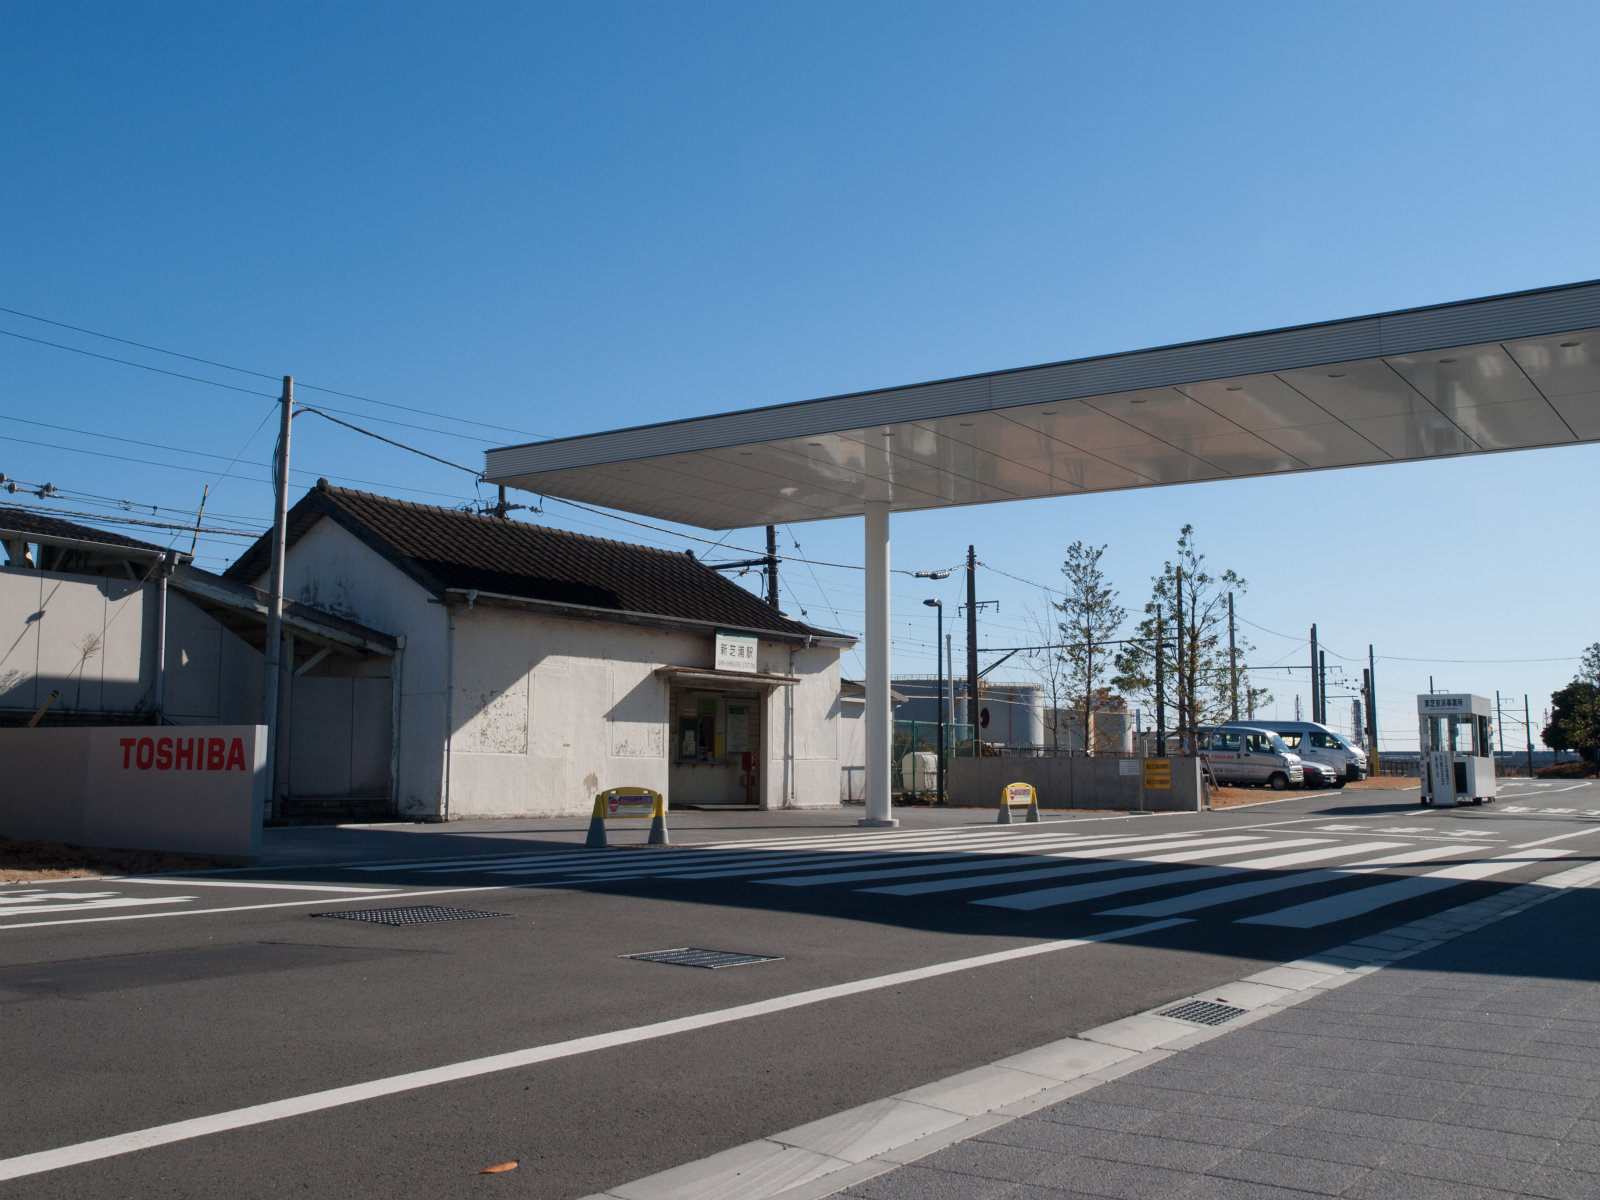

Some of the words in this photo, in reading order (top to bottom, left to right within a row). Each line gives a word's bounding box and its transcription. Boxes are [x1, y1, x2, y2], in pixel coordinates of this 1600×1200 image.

[720, 644, 753, 658] 新芝浦駅
[119, 737, 247, 771] TOSHIBA
